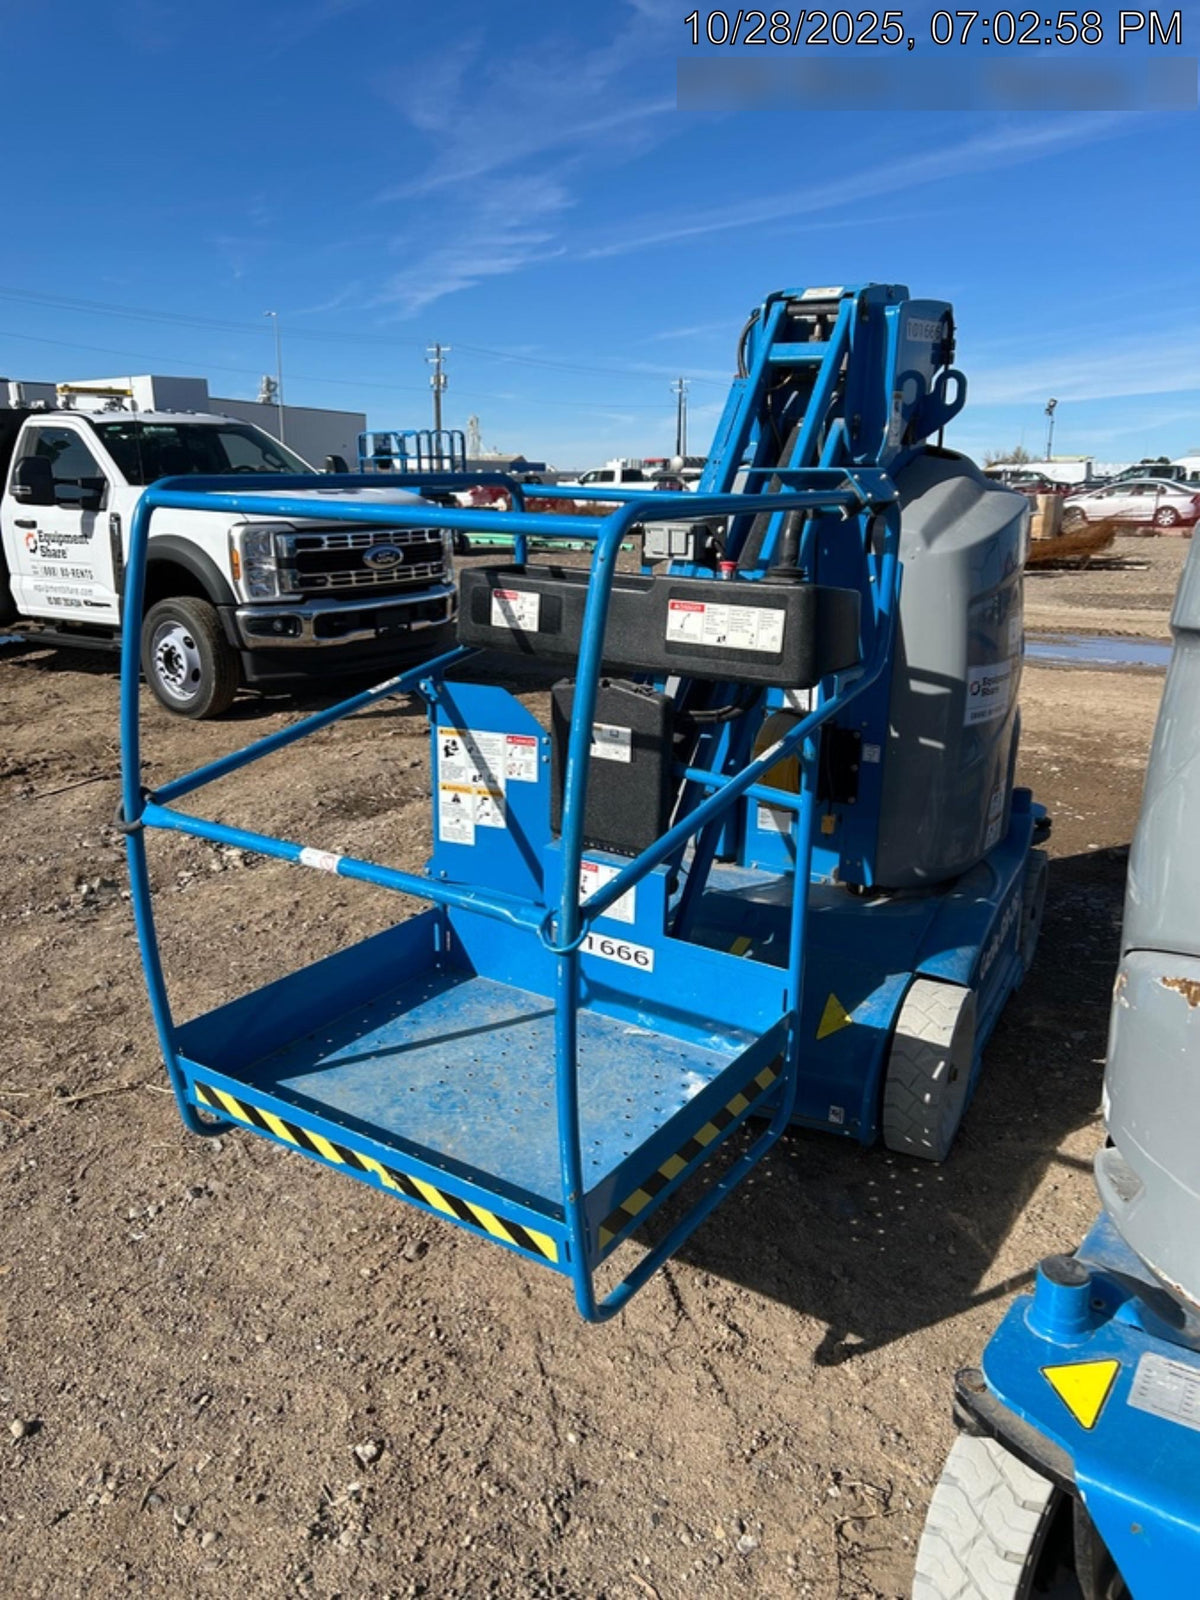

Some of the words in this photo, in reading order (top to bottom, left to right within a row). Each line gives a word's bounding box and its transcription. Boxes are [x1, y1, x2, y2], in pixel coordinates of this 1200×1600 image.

[38, 530, 90, 547] Equipment
[40, 545, 68, 559] Share
[587, 934, 650, 967] 1666
